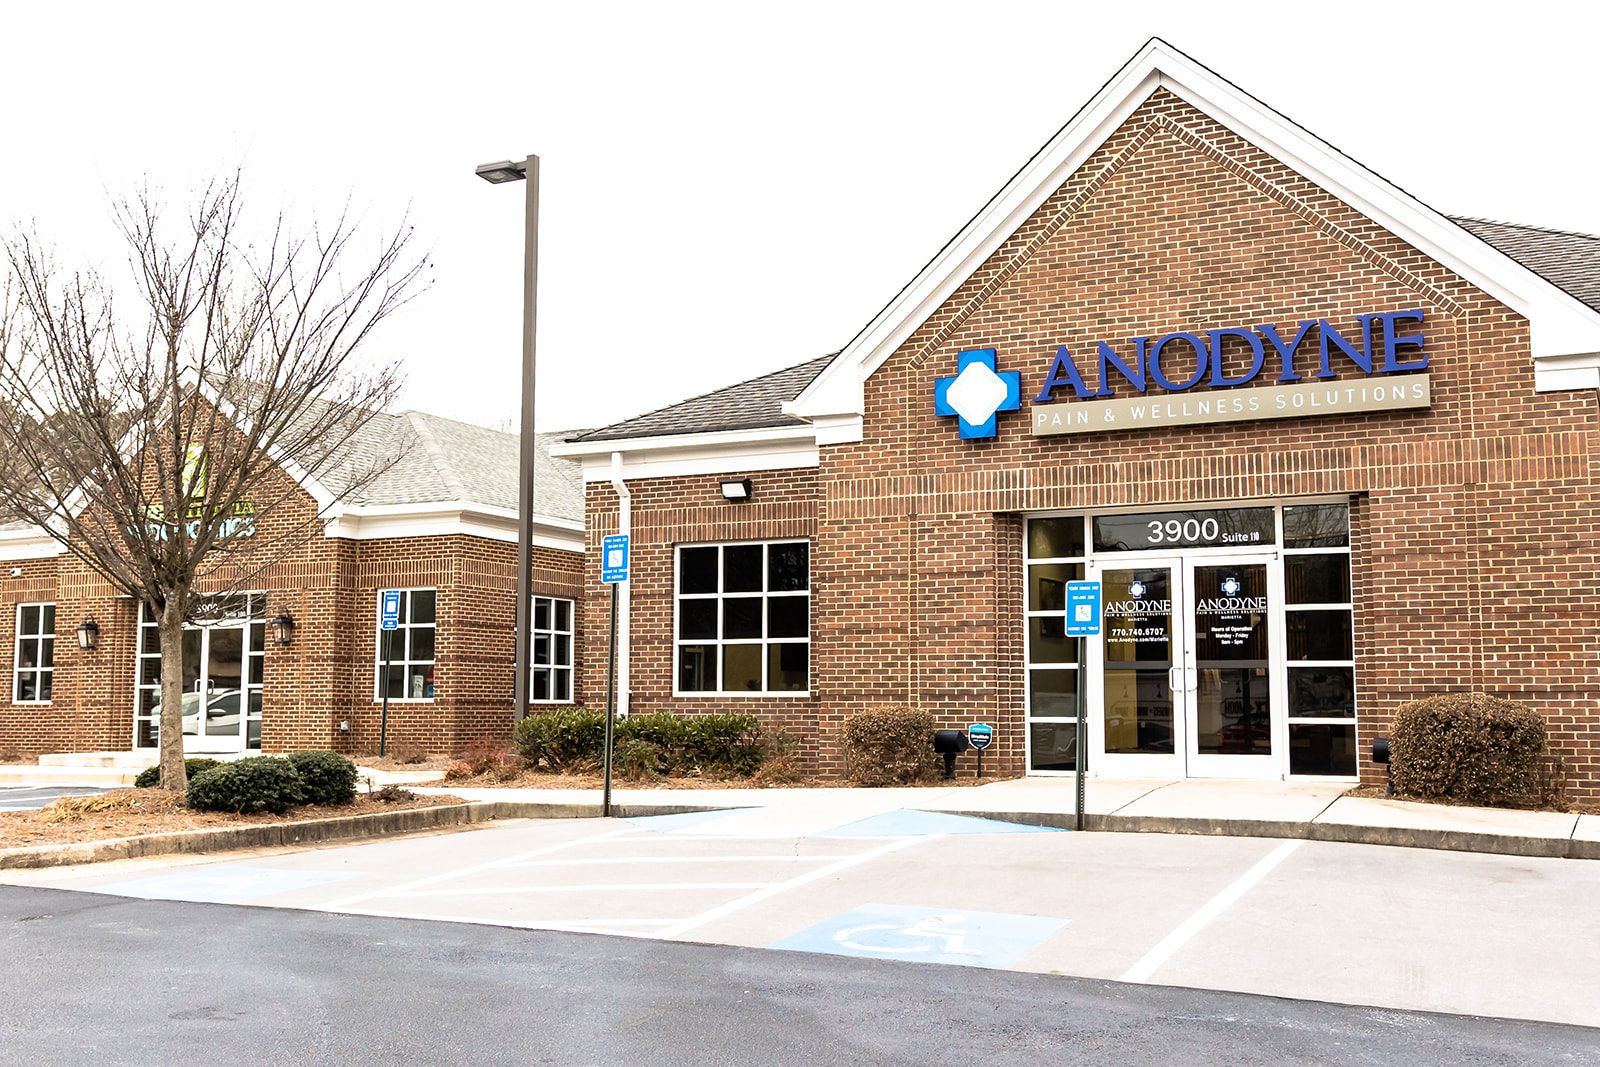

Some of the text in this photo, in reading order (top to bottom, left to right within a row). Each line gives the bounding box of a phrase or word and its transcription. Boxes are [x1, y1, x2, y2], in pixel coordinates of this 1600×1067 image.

[1032, 308, 1430, 403] ANODYNE
[1037, 383, 1425, 427] PAIN & WELLNESS SOLUTIONS
[1147, 518, 1219, 543] 3900
[1221, 533, 1249, 543] Suite
[1104, 600, 1171, 612] ANODYNE
[1196, 597, 1267, 610] ANODYNE
[1112, 628, 1164, 636] 770.740.6707
